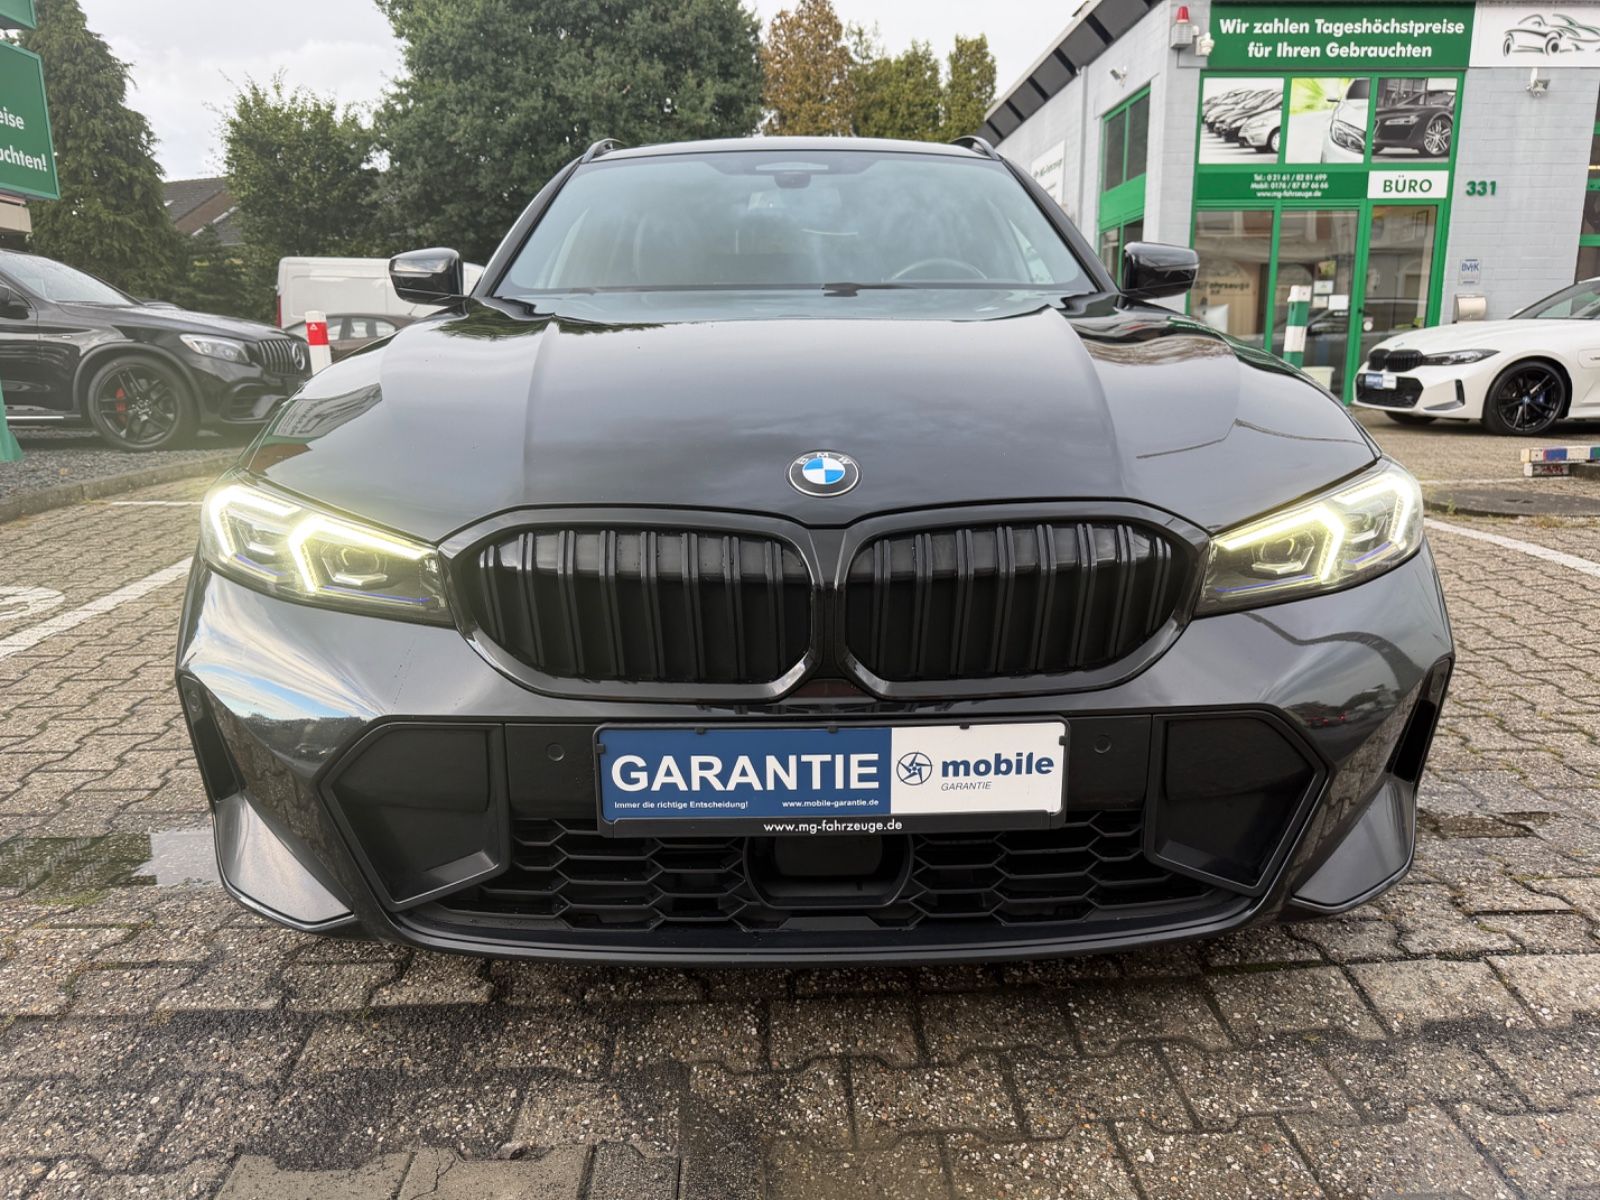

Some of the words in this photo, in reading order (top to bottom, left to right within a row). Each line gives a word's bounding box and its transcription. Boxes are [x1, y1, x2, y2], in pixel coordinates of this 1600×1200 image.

[1219, 18, 1249, 34] Wir
[1253, 18, 1310, 34] zahlen
[1315, 18, 1465, 38] Tageshöchstpreise
[1247, 41, 1272, 58] für
[1276, 41, 1321, 58] Ihren
[1325, 41, 1432, 58] Gebrauchten
[1383, 174, 1433, 193] BÜRO
[1466, 181, 1497, 196] 331
[611, 753, 879, 792] GARANTIE
[941, 752, 1054, 777] mobile
[941, 781, 992, 791] GARANTIE
[614, 801, 640, 809] Immer
[642, 801, 655, 809] die
[657, 801, 688, 810] richtige
[689, 801, 749, 810] Entscheidung!
[782, 799, 879, 808] www.mobile-garantie.de
[763, 819, 902, 834] www.mg-fahrzeuge.de
